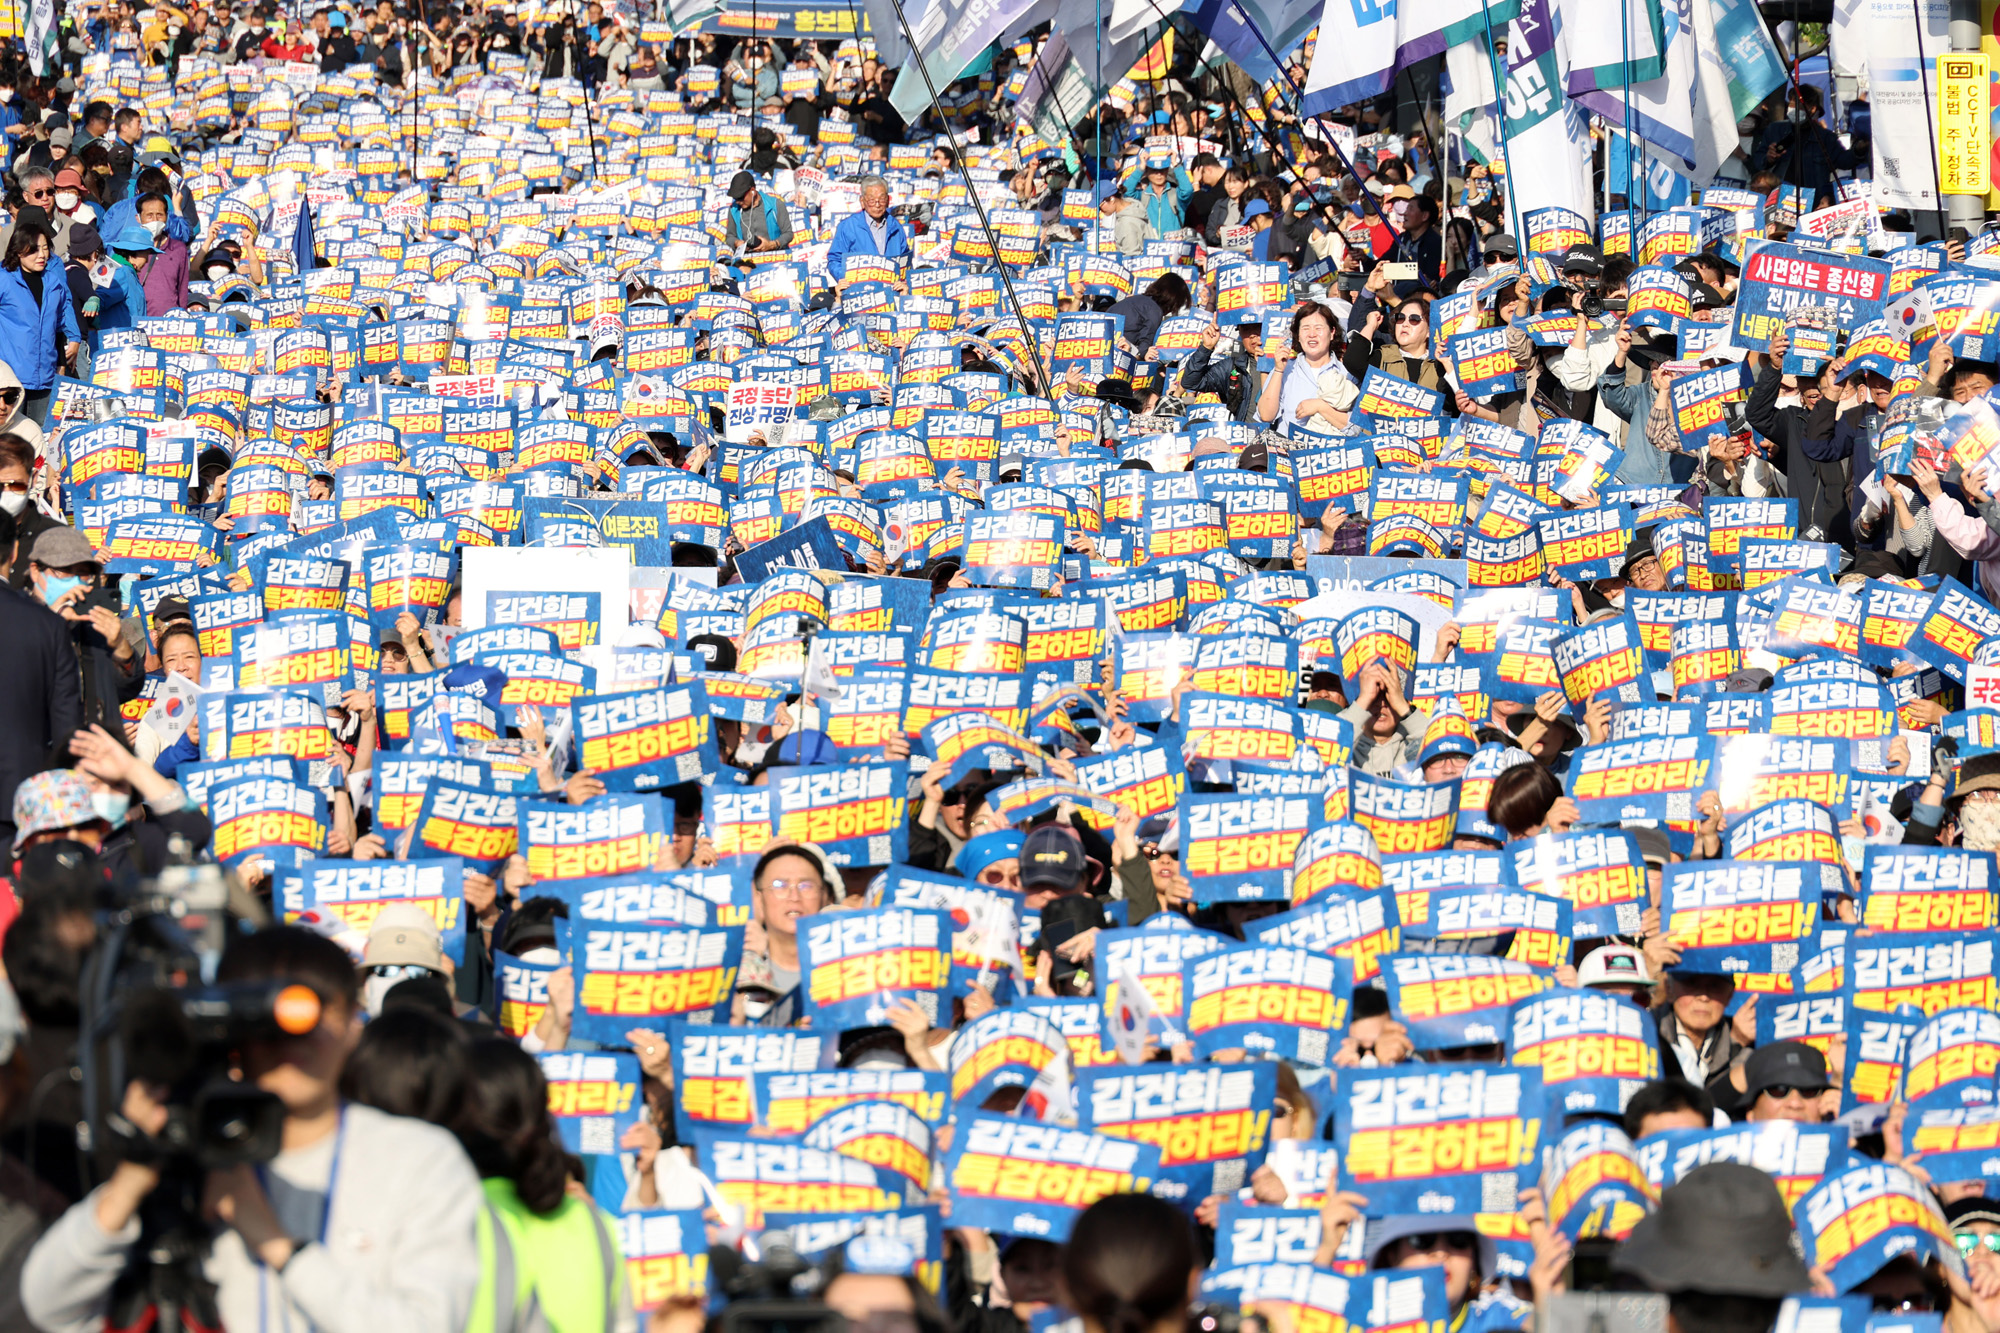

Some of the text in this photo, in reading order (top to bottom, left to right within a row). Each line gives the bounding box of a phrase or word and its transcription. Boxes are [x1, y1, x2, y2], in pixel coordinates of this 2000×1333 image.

[795, 10, 858, 32] 홍보물
[1946, 84, 1961, 115] 불법
[990, 210, 1039, 225] 김건희를
[1527, 210, 1585, 232] 김건희를
[1636, 212, 1691, 246] 김건희를
[845, 255, 893, 270] 김건희를
[1084, 257, 1131, 279] 김건희를
[1568, 250, 1595, 262] Titleist
[654, 271, 703, 288] 김건희를
[845, 268, 899, 283] 특검하라!
[945, 276, 994, 298] 김건희를
[1083, 271, 1133, 294] 특검하라!
[1219, 265, 1281, 290] 김건희를
[1629, 269, 1690, 295] 김건희를
[1755, 256, 1876, 298] 사면없는 종신형
[1217, 283, 1287, 310] 특검하라!
[137, 319, 198, 337] 김건희를
[511, 305, 563, 326] 김건희를
[1059, 322, 1105, 340] 김건희를
[276, 330, 327, 354] 김건희를
[627, 330, 687, 352] 김건희를
[1054, 340, 1111, 358] 특검하라!
[275, 347, 331, 373] 특검하라!
[627, 347, 693, 372] 특검하라!
[903, 352, 953, 371] 김건희를
[187, 371, 246, 393] 김건희를
[435, 378, 495, 397] 국정농단
[672, 365, 736, 386] 김건희를
[901, 367, 960, 384] 특검하라!
[1673, 368, 1740, 407] 김건희를
[896, 383, 953, 407] 김건희를
[1367, 376, 1437, 411] 김건희를
[445, 406, 513, 431] 김건희를
[519, 420, 589, 444] 김건희를
[827, 409, 891, 439] 김건희를
[927, 414, 995, 436] 김건희를
[67, 425, 139, 460] 김건희를
[334, 420, 395, 450] 김건희를
[861, 433, 926, 458] 김건희를
[927, 436, 1000, 459] 특검하라!
[71, 446, 145, 486] 특검하라!
[333, 441, 400, 467] 특검하라!
[518, 441, 594, 467] 특검하라!
[857, 455, 936, 482] 특검하라!
[1295, 446, 1364, 476] 김건희를
[342, 473, 419, 498] 김건희를
[648, 479, 722, 502] 김건희를
[991, 487, 1068, 510] 김건희를
[1299, 466, 1375, 501] 특검하라!
[1377, 477, 1458, 500] 김건희를
[603, 516, 659, 538] 여론조작
[970, 514, 1055, 540] 김건희를
[1150, 501, 1220, 527] 김건희를
[1540, 509, 1620, 541] 김건희를
[1709, 502, 1787, 526] 김건희를
[115, 521, 202, 544] 김건희를
[1149, 525, 1228, 556] 특검하라!
[1465, 532, 1537, 560] 김건희를
[1543, 528, 1632, 567] 특검하라!
[370, 549, 450, 578] 김건희를
[965, 540, 1062, 565] 특검하라!
[1744, 544, 1828, 568] 김건희를
[266, 556, 344, 584] 김건희를
[1468, 553, 1546, 584] 특검하라!
[264, 582, 346, 610] 특검하라!
[370, 576, 452, 611] 특검하라!
[748, 574, 825, 614] 김건희를
[1234, 577, 1310, 602] 김건희를
[493, 596, 587, 622] 김건희를
[1633, 596, 1725, 622] 김건희를
[456, 628, 551, 658] 김건희를
[1338, 606, 1413, 655] 김건희를
[1199, 633, 1287, 669] 김건희를
[1342, 633, 1417, 679] 특검하라!
[1554, 622, 1629, 675] 김건희를
[1193, 666, 1297, 699] 특검하라!
[1562, 646, 1643, 702] 특검하라!
[910, 673, 1020, 707] 김건희를
[1772, 682, 1880, 713] 김건희를
[232, 697, 322, 733] 김건희를
[580, 688, 692, 738] 김건희를
[1188, 700, 1293, 733] 김건희를
[1769, 708, 1894, 738] 특검하라!
[582, 714, 709, 772] 특검하라!
[1581, 736, 1699, 774] 김건희를
[778, 767, 892, 811] 김건희를
[1573, 759, 1710, 797] 특검하라!
[213, 779, 315, 825] 김건희를
[1354, 780, 1452, 820] 김건희를
[527, 804, 644, 843] 김건희를
[778, 798, 905, 842] 특검하라!
[1189, 797, 1309, 839] 김건희를
[1731, 801, 1833, 857] 김건희를
[213, 810, 326, 860] 특검하라!
[313, 864, 444, 901] 김건희를
[1382, 854, 1500, 892] 김건희를
[1671, 864, 1801, 909] 김건희를
[1871, 854, 1988, 891] 김건희를
[581, 882, 707, 926] 김건희를
[1437, 892, 1558, 932] 김건희를
[1864, 892, 1999, 930] 특검하라!
[808, 909, 939, 965] 김건희를
[1667, 901, 1817, 948] 특검하라!
[585, 930, 727, 971] 김건희를
[1853, 940, 1993, 988] 김건희를
[809, 950, 950, 1002] 특검하라!
[1193, 953, 1334, 998] 김건희를
[1393, 953, 1532, 985] 김건희를
[581, 966, 738, 1014] 특검하라!
[1398, 974, 1554, 1016] 특검하라!
[1188, 985, 1348, 1031] 특검하라!
[1512, 994, 1643, 1049] 김건희를
[682, 1032, 820, 1076] 김건희를
[768, 1070, 925, 1099] 김건희를
[1092, 1067, 1254, 1123] 김건희를
[1349, 1069, 1519, 1128] 김건희를
[966, 1118, 1139, 1172] 김건희를
[1345, 1117, 1540, 1180] 특검하라!
[713, 1140, 877, 1186] 김건희를
